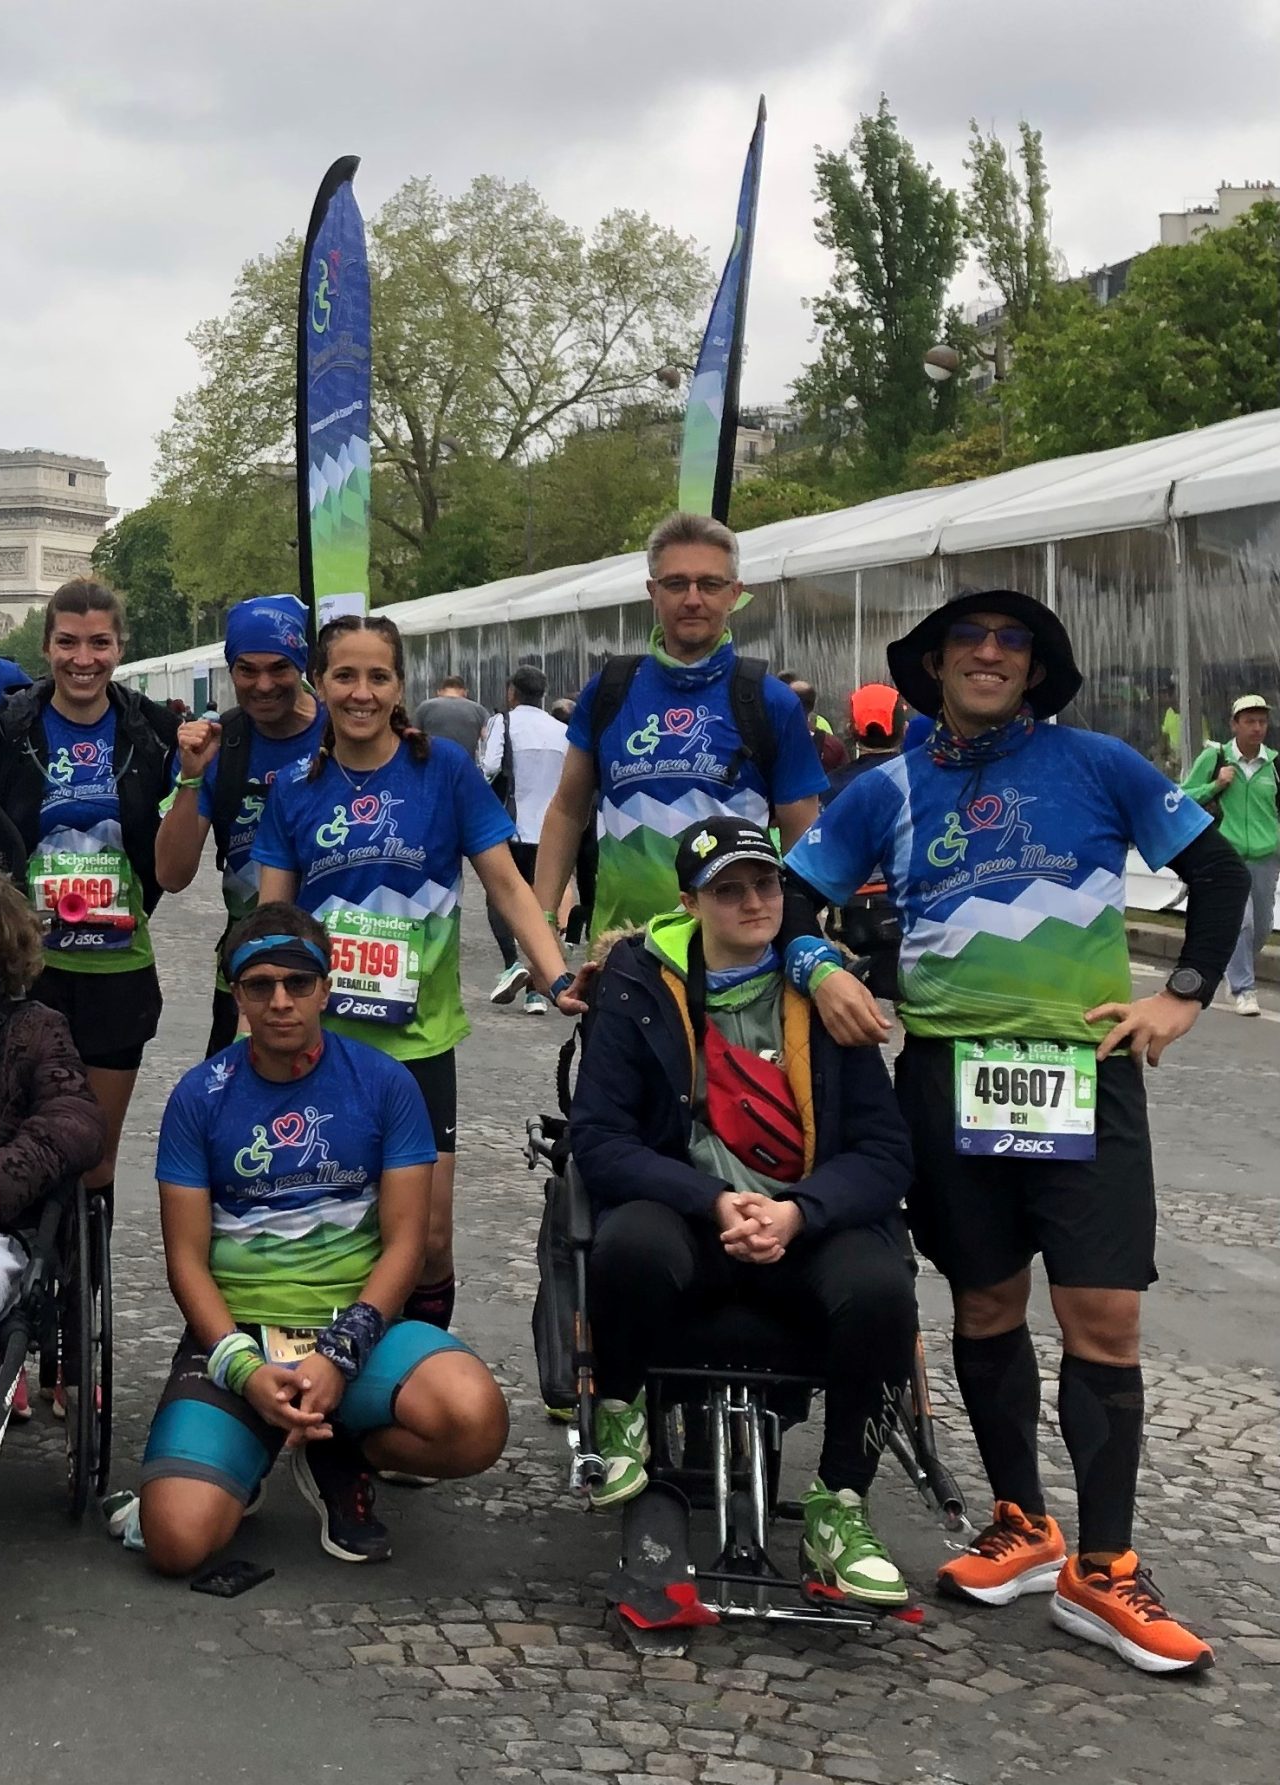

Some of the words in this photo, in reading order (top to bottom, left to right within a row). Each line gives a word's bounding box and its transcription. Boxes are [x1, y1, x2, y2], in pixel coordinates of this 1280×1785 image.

[654, 759, 691, 776] pour
[57, 853, 121, 866] Schneider
[347, 846, 381, 866] pour
[382, 836, 427, 862] Marie
[921, 865, 970, 902] Courir
[973, 856, 1017, 884] pour
[1021, 844, 1078, 870] Marie
[343, 911, 413, 932] Schneider
[74, 934, 105, 946] asics
[329, 937, 399, 978] 55199
[352, 1001, 388, 1017] asics
[1028, 1053, 1077, 1064] Electric
[974, 1066, 1066, 1108] 49607
[1010, 1111, 1028, 1125] BEN
[1013, 1137, 1056, 1153] asics
[273, 1172, 314, 1194] pour
[316, 1160, 369, 1184] Marie
